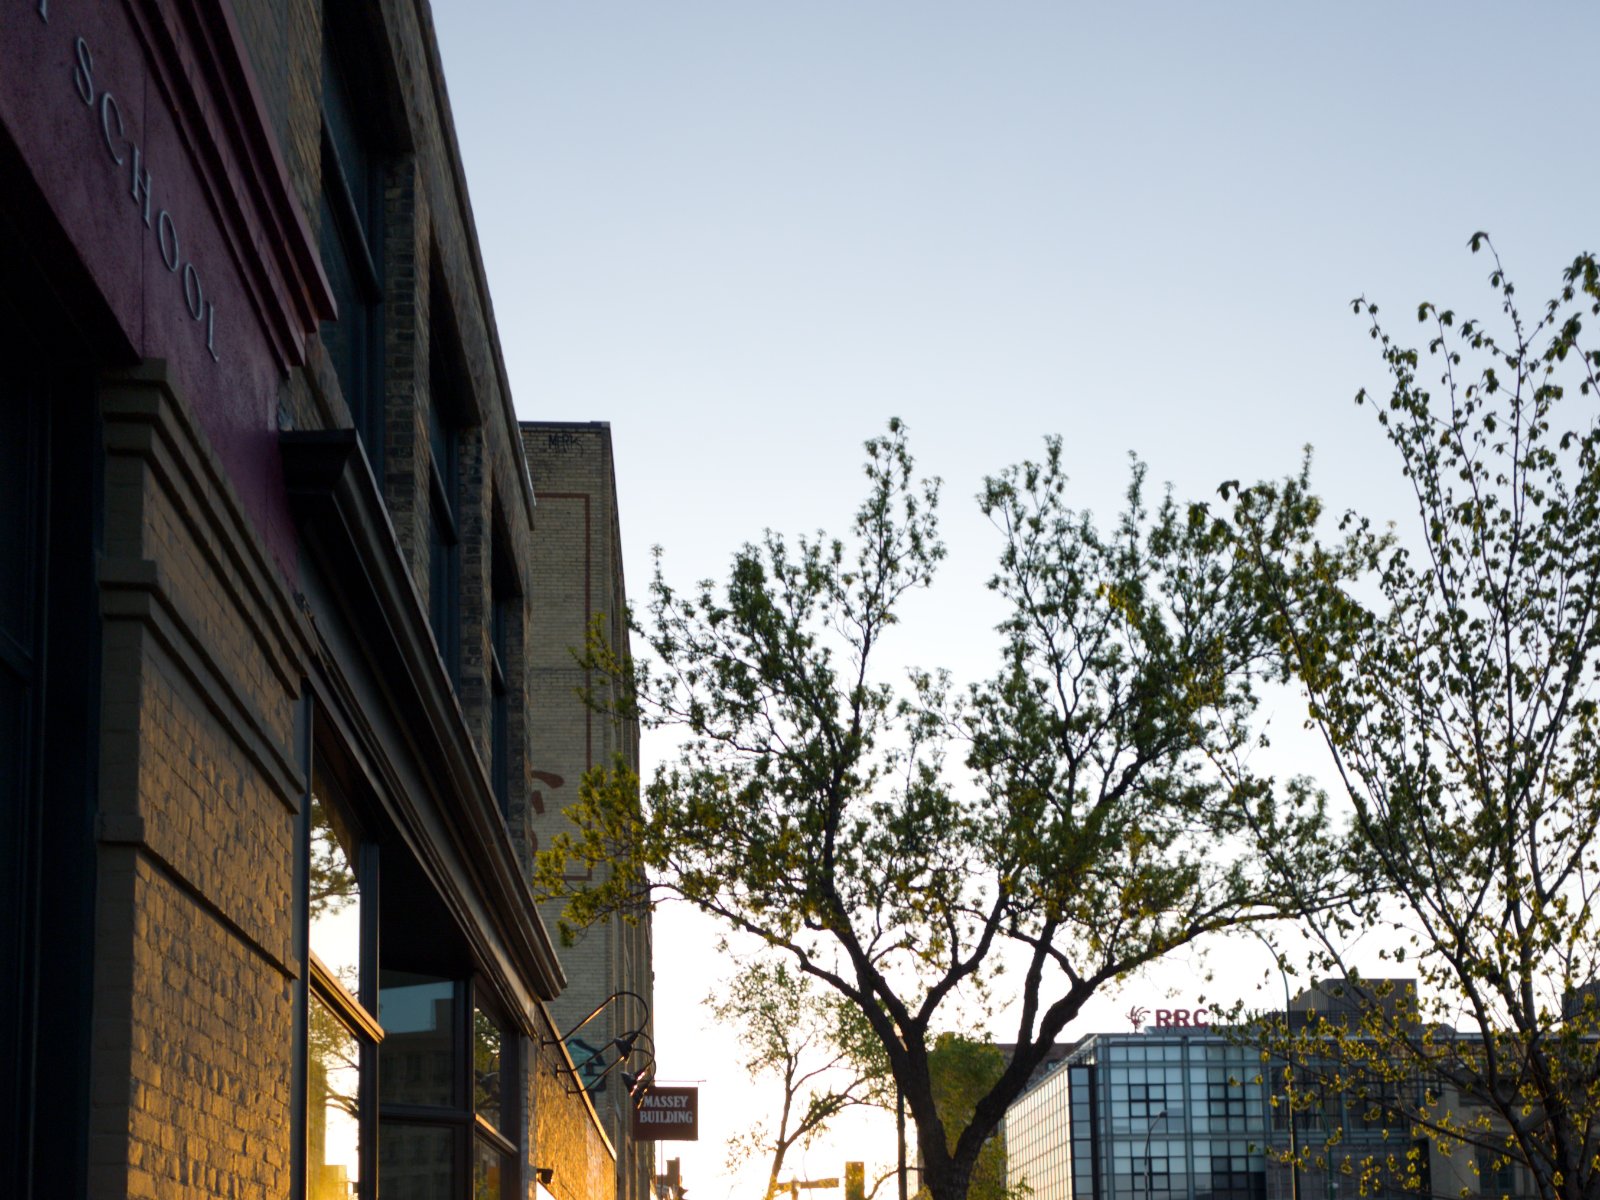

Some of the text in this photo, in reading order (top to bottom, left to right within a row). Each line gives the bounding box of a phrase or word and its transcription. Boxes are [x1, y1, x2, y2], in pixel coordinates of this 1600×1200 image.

[73, 36, 219, 362] SCHOOL
[1155, 1008, 1210, 1029] RRC
[643, 1095, 689, 1108] MASSEY
[640, 1110, 693, 1124] BUILDING
